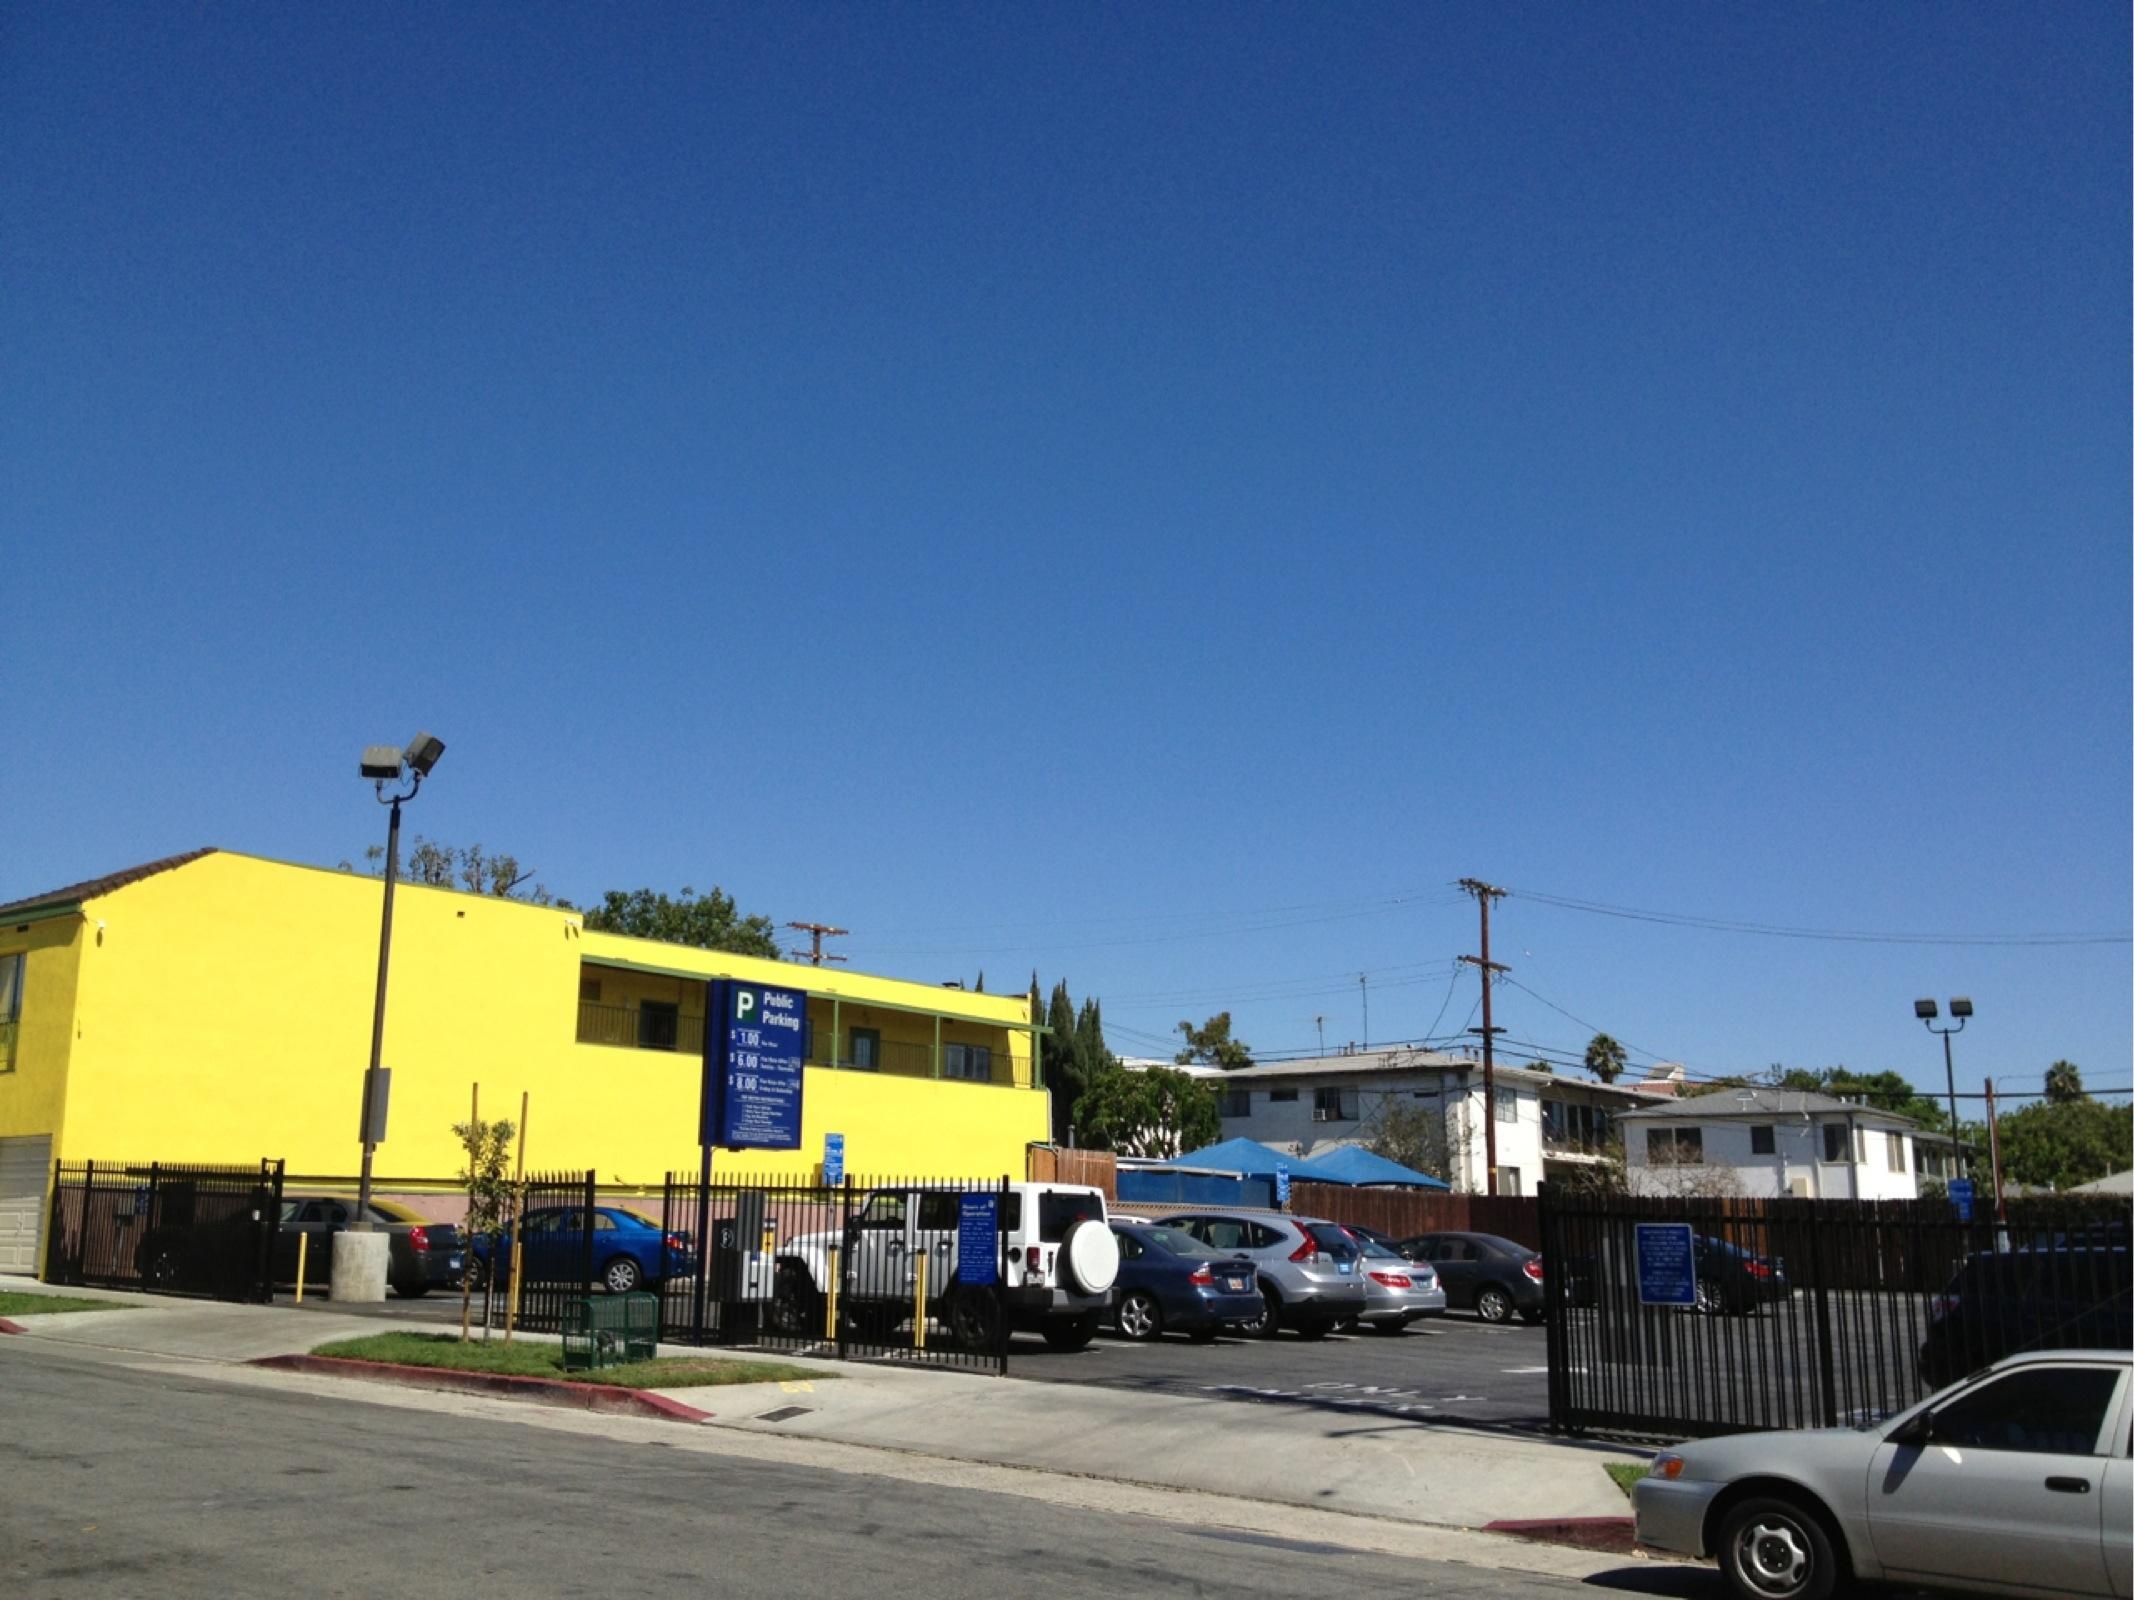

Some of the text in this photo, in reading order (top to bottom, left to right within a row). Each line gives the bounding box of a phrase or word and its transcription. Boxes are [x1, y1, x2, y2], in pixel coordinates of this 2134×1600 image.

[737, 991, 753, 1019] P
[764, 991, 793, 1009] Public
[762, 1010, 799, 1032] Parking
